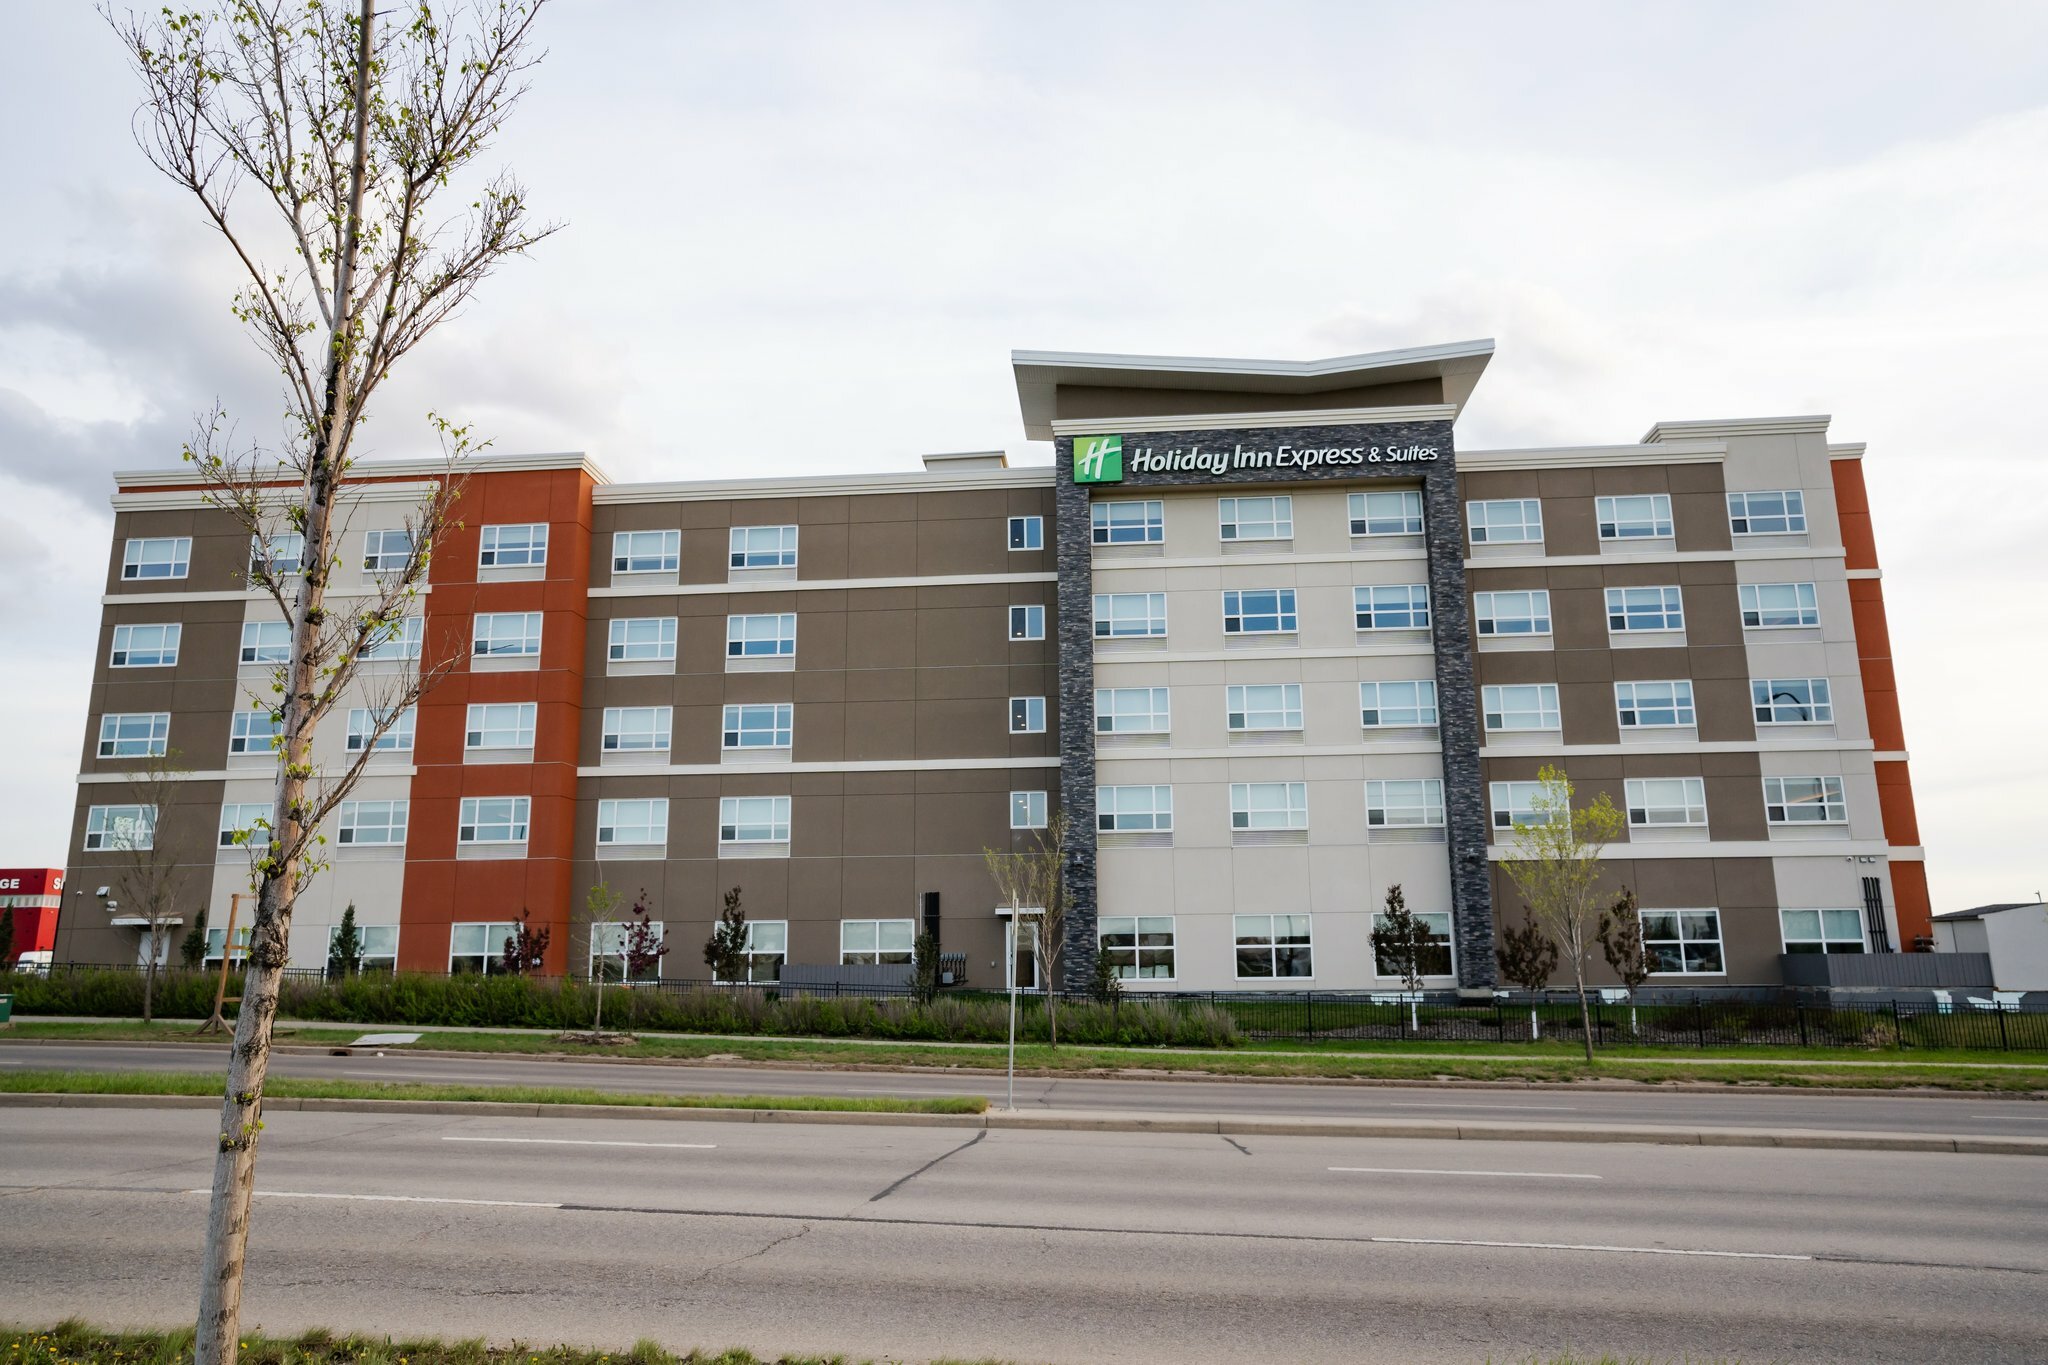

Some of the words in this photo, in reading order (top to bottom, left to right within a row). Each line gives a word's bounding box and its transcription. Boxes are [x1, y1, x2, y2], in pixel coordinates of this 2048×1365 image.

[1130, 446, 1229, 475] Holiday
[1233, 444, 1272, 469] Inn
[1275, 445, 1364, 472] Express
[1368, 446, 1381, 463] &
[1385, 445, 1438, 462] Suites
